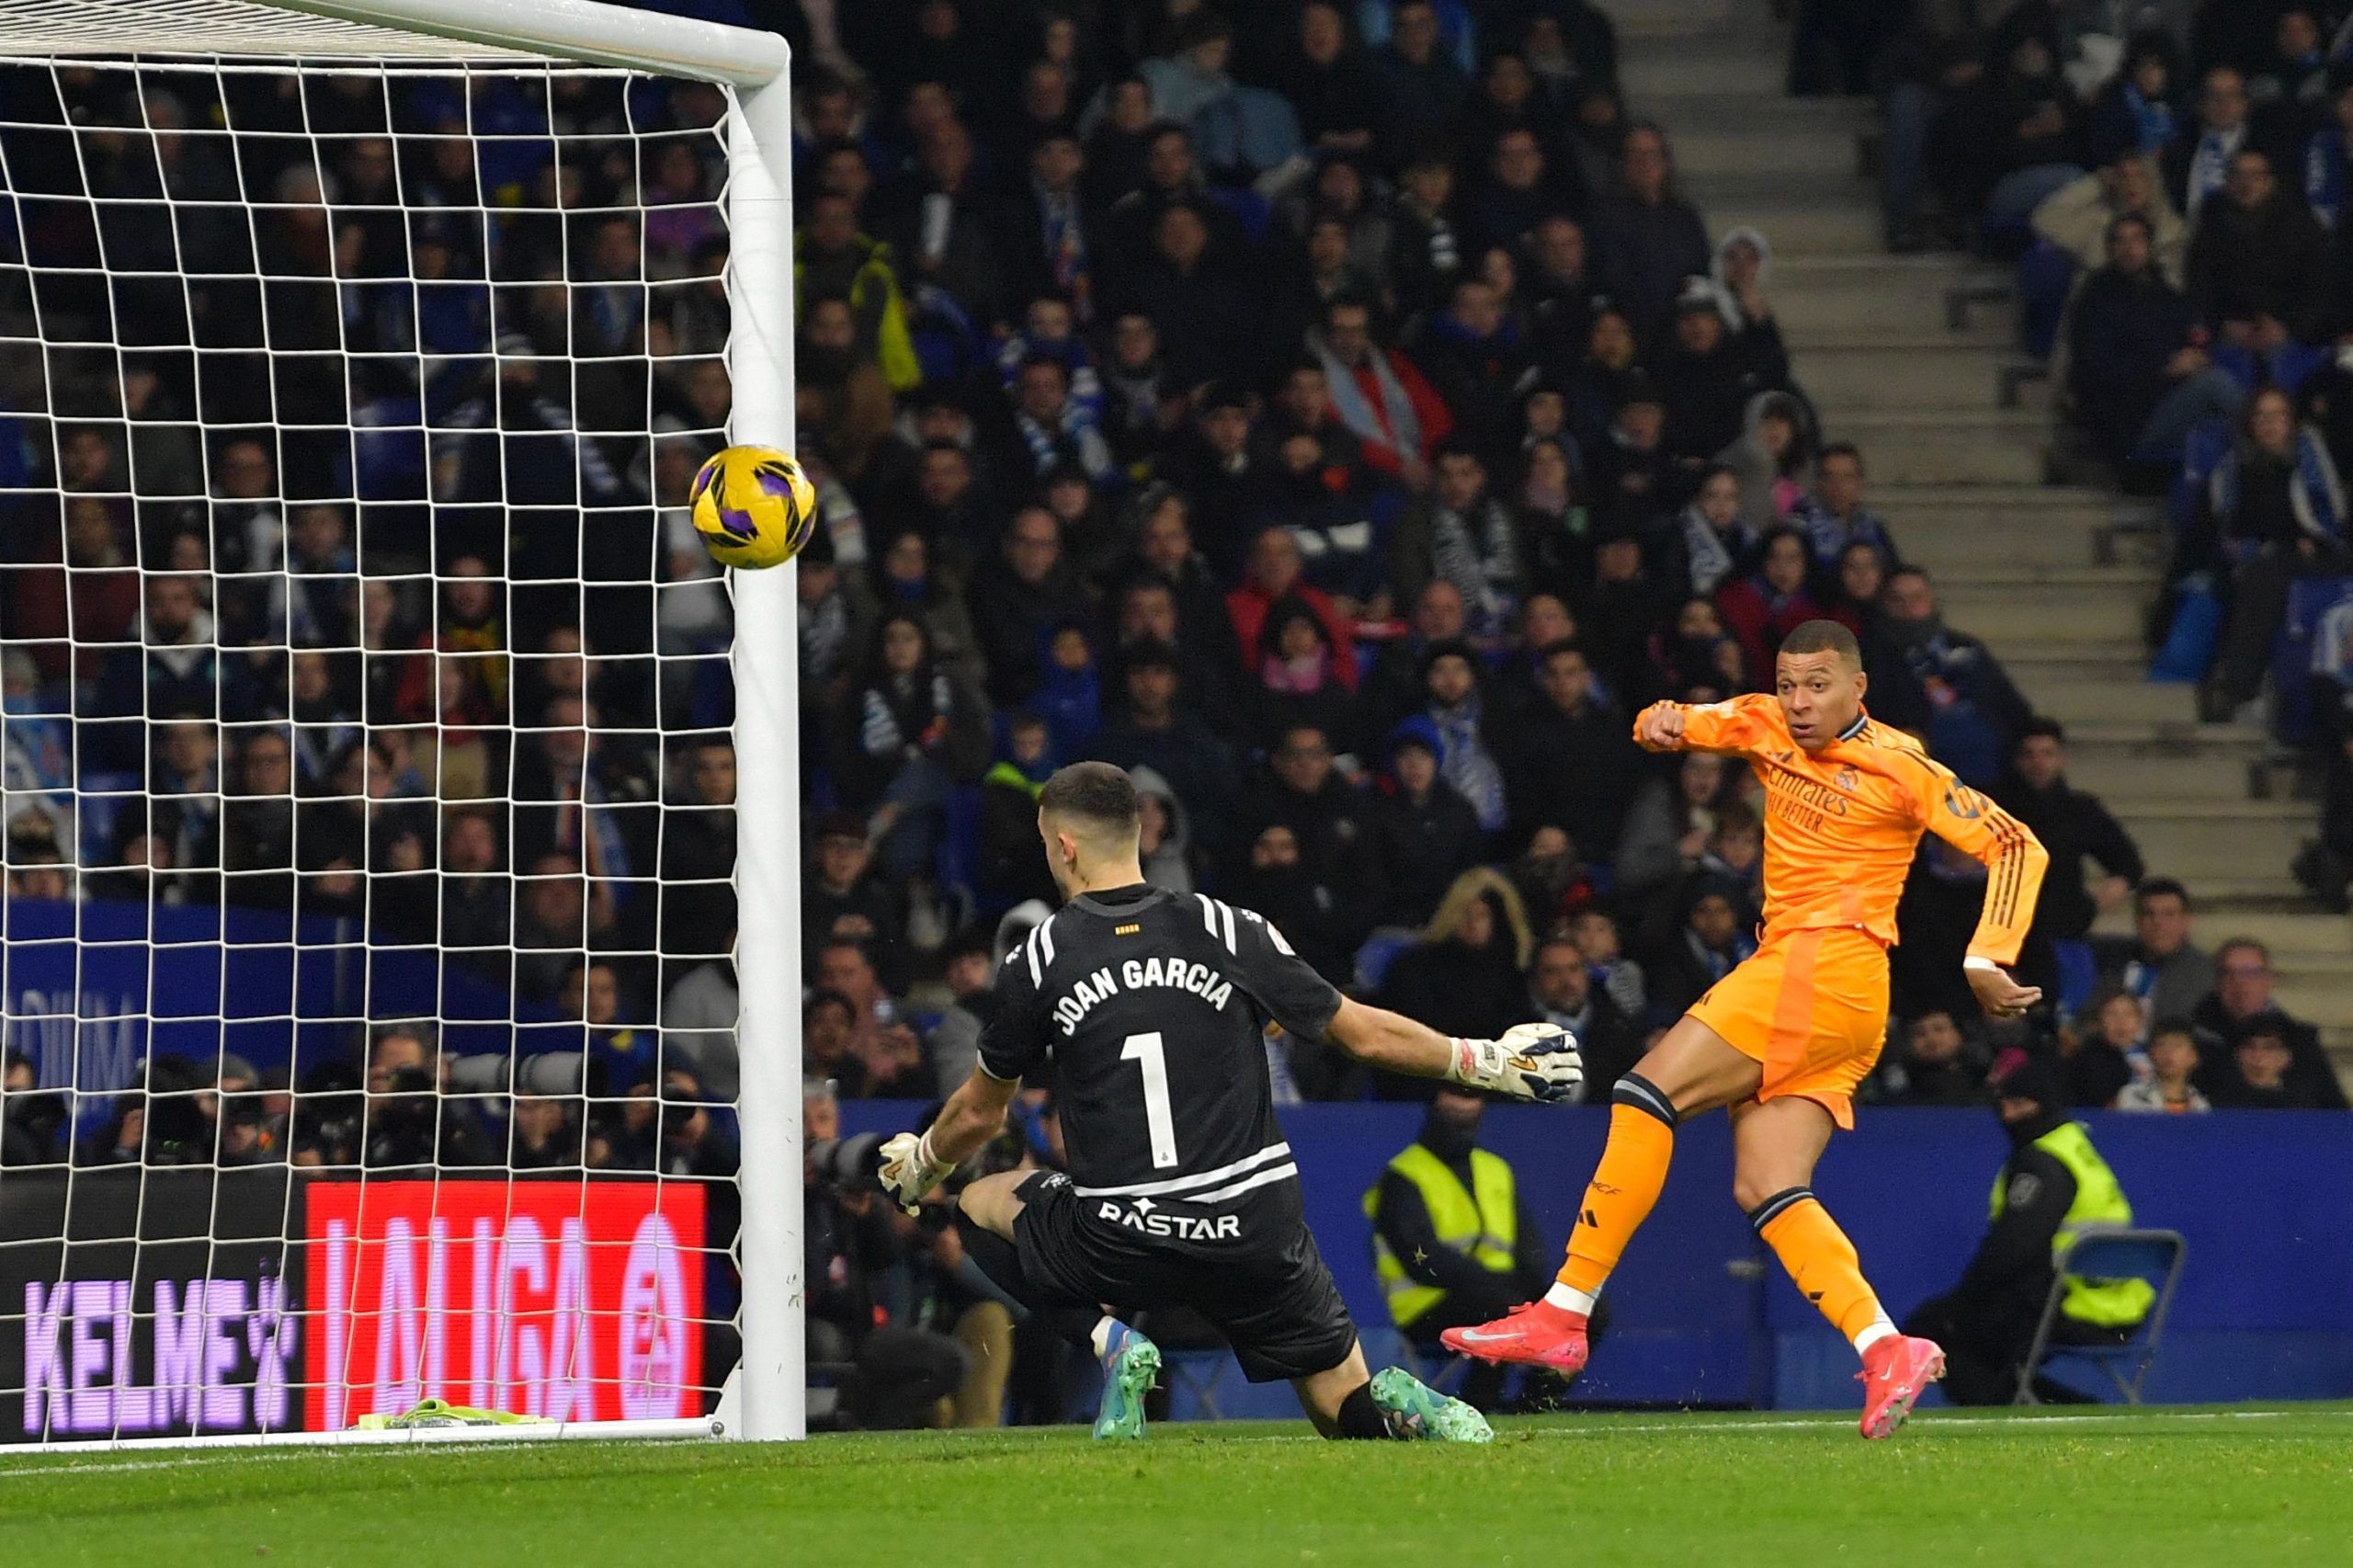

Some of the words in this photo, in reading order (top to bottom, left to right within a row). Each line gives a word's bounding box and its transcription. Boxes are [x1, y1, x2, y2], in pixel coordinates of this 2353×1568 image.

[1768, 764, 1849, 817] Emirates
[1781, 800, 1824, 834] BETTER
[1052, 967, 1119, 1036] JOAN
[1122, 958, 1233, 1011] GARCIA
[1120, 1031, 1178, 1168] 1
[1098, 1201, 1241, 1240] RASTAR
[23, 1278, 248, 1435] KELME
